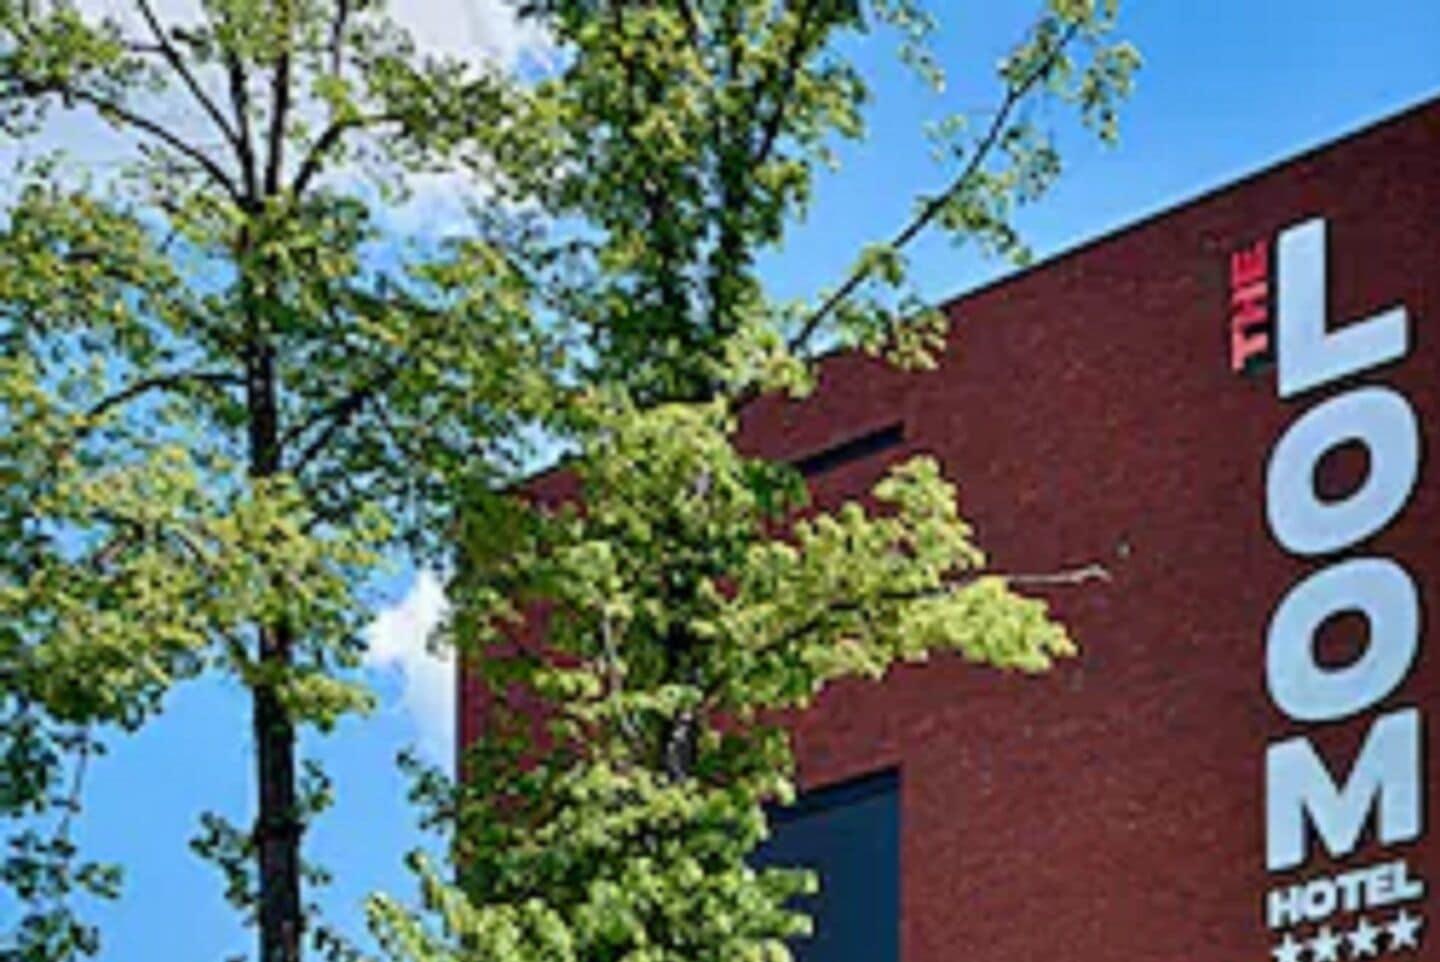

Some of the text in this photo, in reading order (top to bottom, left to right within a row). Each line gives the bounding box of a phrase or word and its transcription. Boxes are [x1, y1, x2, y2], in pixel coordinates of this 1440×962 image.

[1231, 241, 1267, 369] THE
[1266, 218, 1421, 871] LOOM
[1267, 861, 1423, 928] HOTEL
